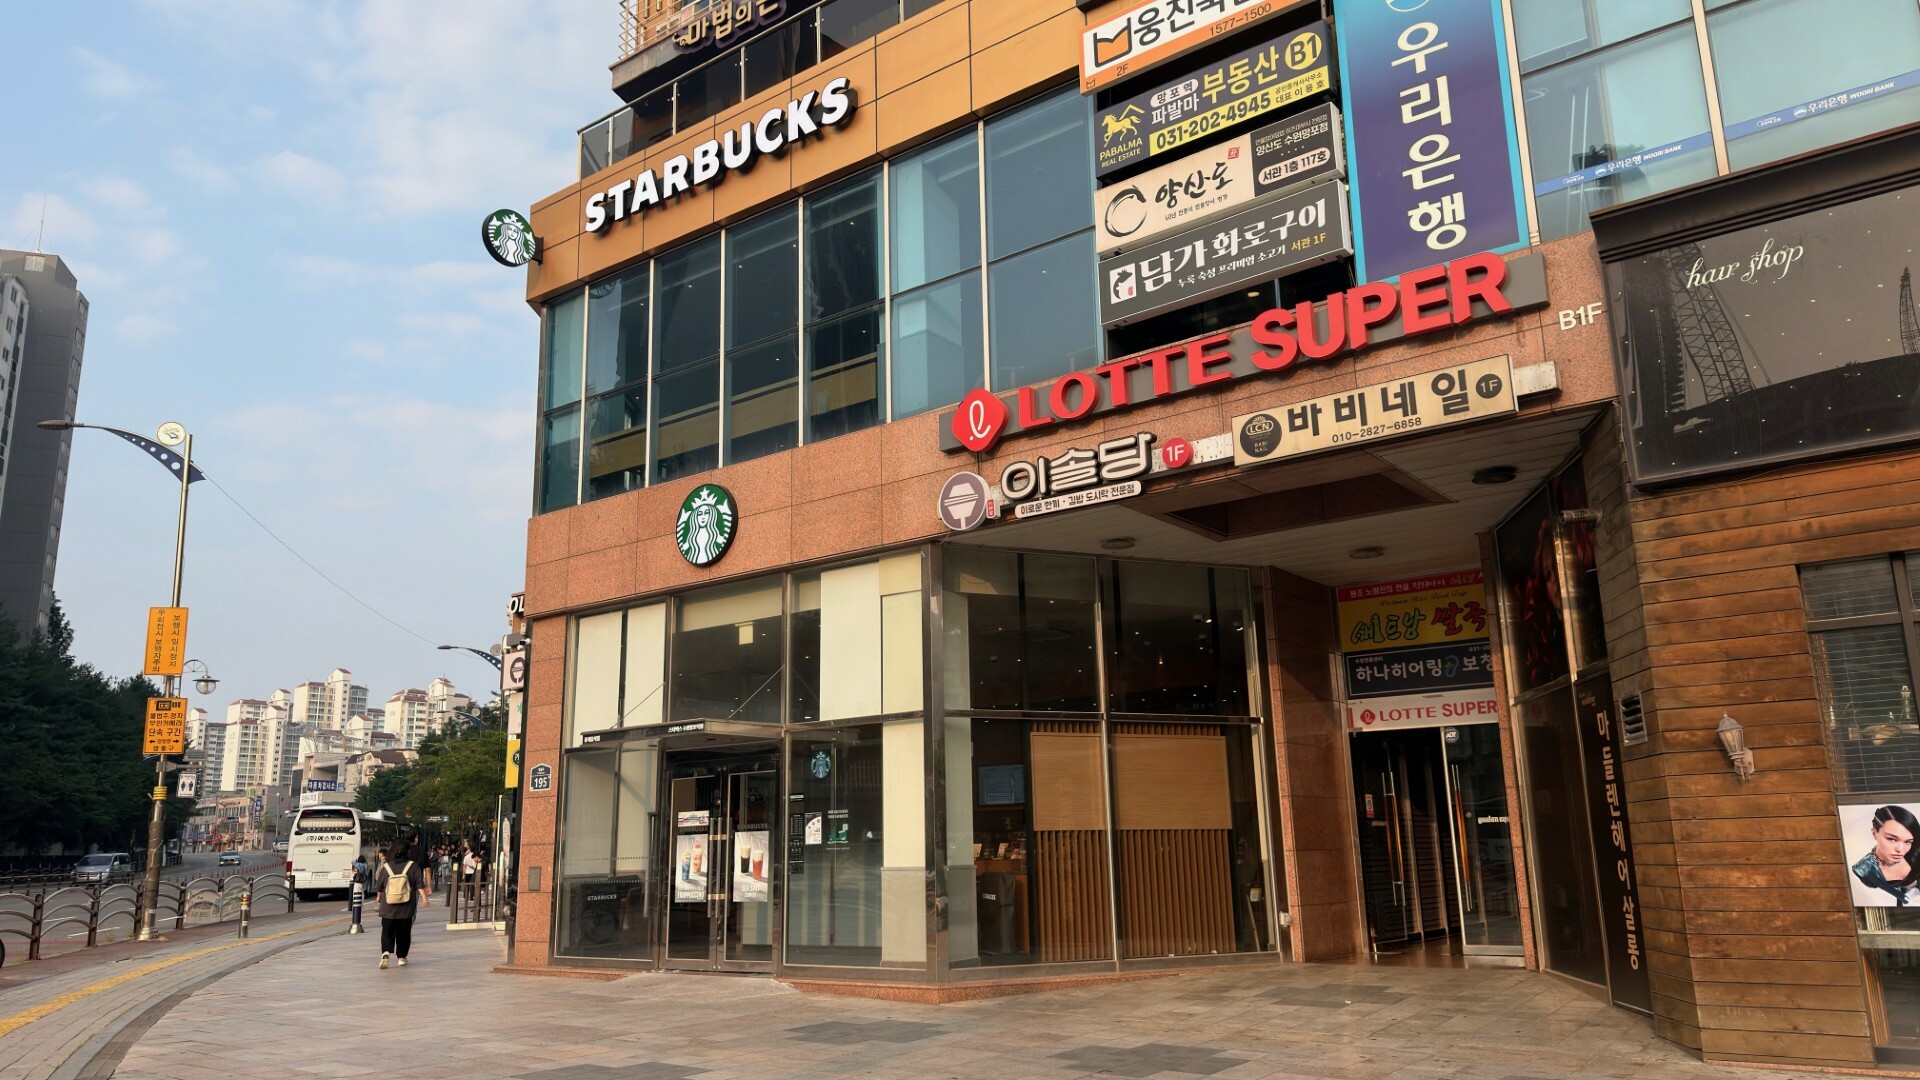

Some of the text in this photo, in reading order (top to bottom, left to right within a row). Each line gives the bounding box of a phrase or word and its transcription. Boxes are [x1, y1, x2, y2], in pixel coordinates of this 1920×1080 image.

[1209, 3, 1271, 36] 1577-1500
[1116, 63, 1129, 77] 2F
[1157, 34, 1318, 105] 망포역 부동산 B1
[1151, 98, 1199, 124] 파발마
[1276, 91, 1292, 104] 대표
[1808, 81, 1895, 113] 우리은행 WOORI BANK
[1156, 93, 1271, 150] 031-202-4945
[1391, 21, 1467, 250] 우리은행
[1099, 138, 1143, 161] PABALMA
[1256, 139, 1282, 156] 양산도
[1284, 122, 1328, 145] 수원망포점
[585, 76, 853, 233] STARBUCKS
[1101, 148, 1141, 168] REAL ESTATE
[1263, 166, 1281, 182] 서관
[1301, 151, 1326, 168] 117호
[1607, 144, 1682, 172] 우리은행 WOORI BANK
[1155, 162, 1233, 209] 양산도
[1291, 232, 1326, 252] 서관 1F
[1197, 267, 1216, 281] 숙성
[1217, 256, 1255, 274] 프리미엄
[1257, 245, 1286, 262] 소고기
[1686, 238, 1803, 289] hair shop
[1558, 302, 1603, 331] B1F
[1016, 251, 1517, 430] LOTTE SUPER
[1480, 380, 1498, 394] 1F
[1250, 422, 1270, 434] LCN
[1331, 417, 1422, 443] 010-2827-6858
[1001, 430, 1185, 500] 이솔당 1F
[1020, 500, 1043, 515] 이로운
[1067, 494, 1085, 506] 김밥
[1085, 488, 1109, 503] 도시락
[1110, 484, 1135, 498] 전문점
[1355, 659, 1443, 682] 하나히어링
[1380, 700, 1498, 722] LOTTE SUPER
[534, 777, 548, 788] 195
[587, 894, 617, 902] STARBUCKS
